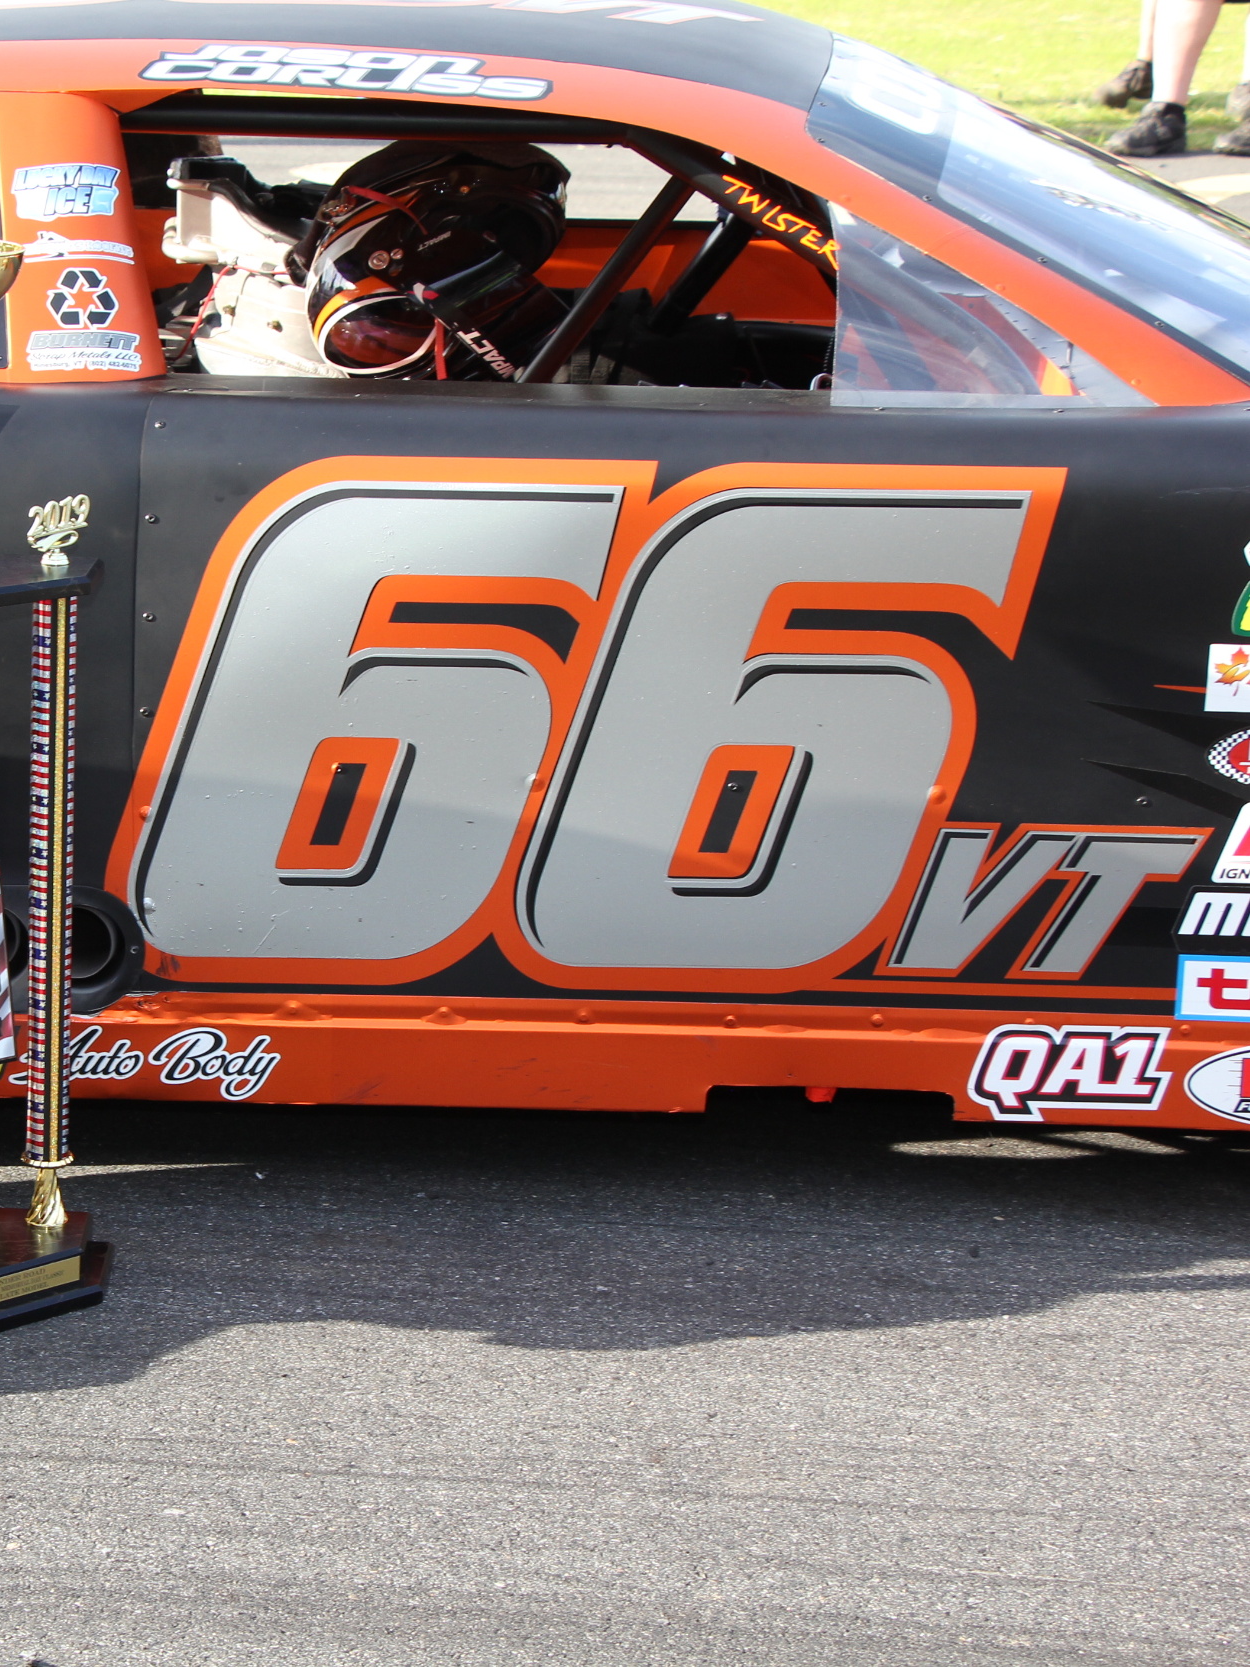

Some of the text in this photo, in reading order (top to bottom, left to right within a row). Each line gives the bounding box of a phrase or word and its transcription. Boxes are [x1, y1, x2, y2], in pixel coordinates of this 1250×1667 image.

[43, 185, 93, 216] ICE
[78, 165, 118, 188] DAY
[721, 174, 842, 271] TWISTER
[30, 331, 137, 350] BURNETT
[28, 493, 91, 537] 2019
[112, 465, 1050, 980] 66
[880, 825, 1206, 976] VT
[148, 1026, 282, 1101] Body
[977, 1032, 1162, 1113] QA1
[23, 1268, 45, 1279] ROAD
